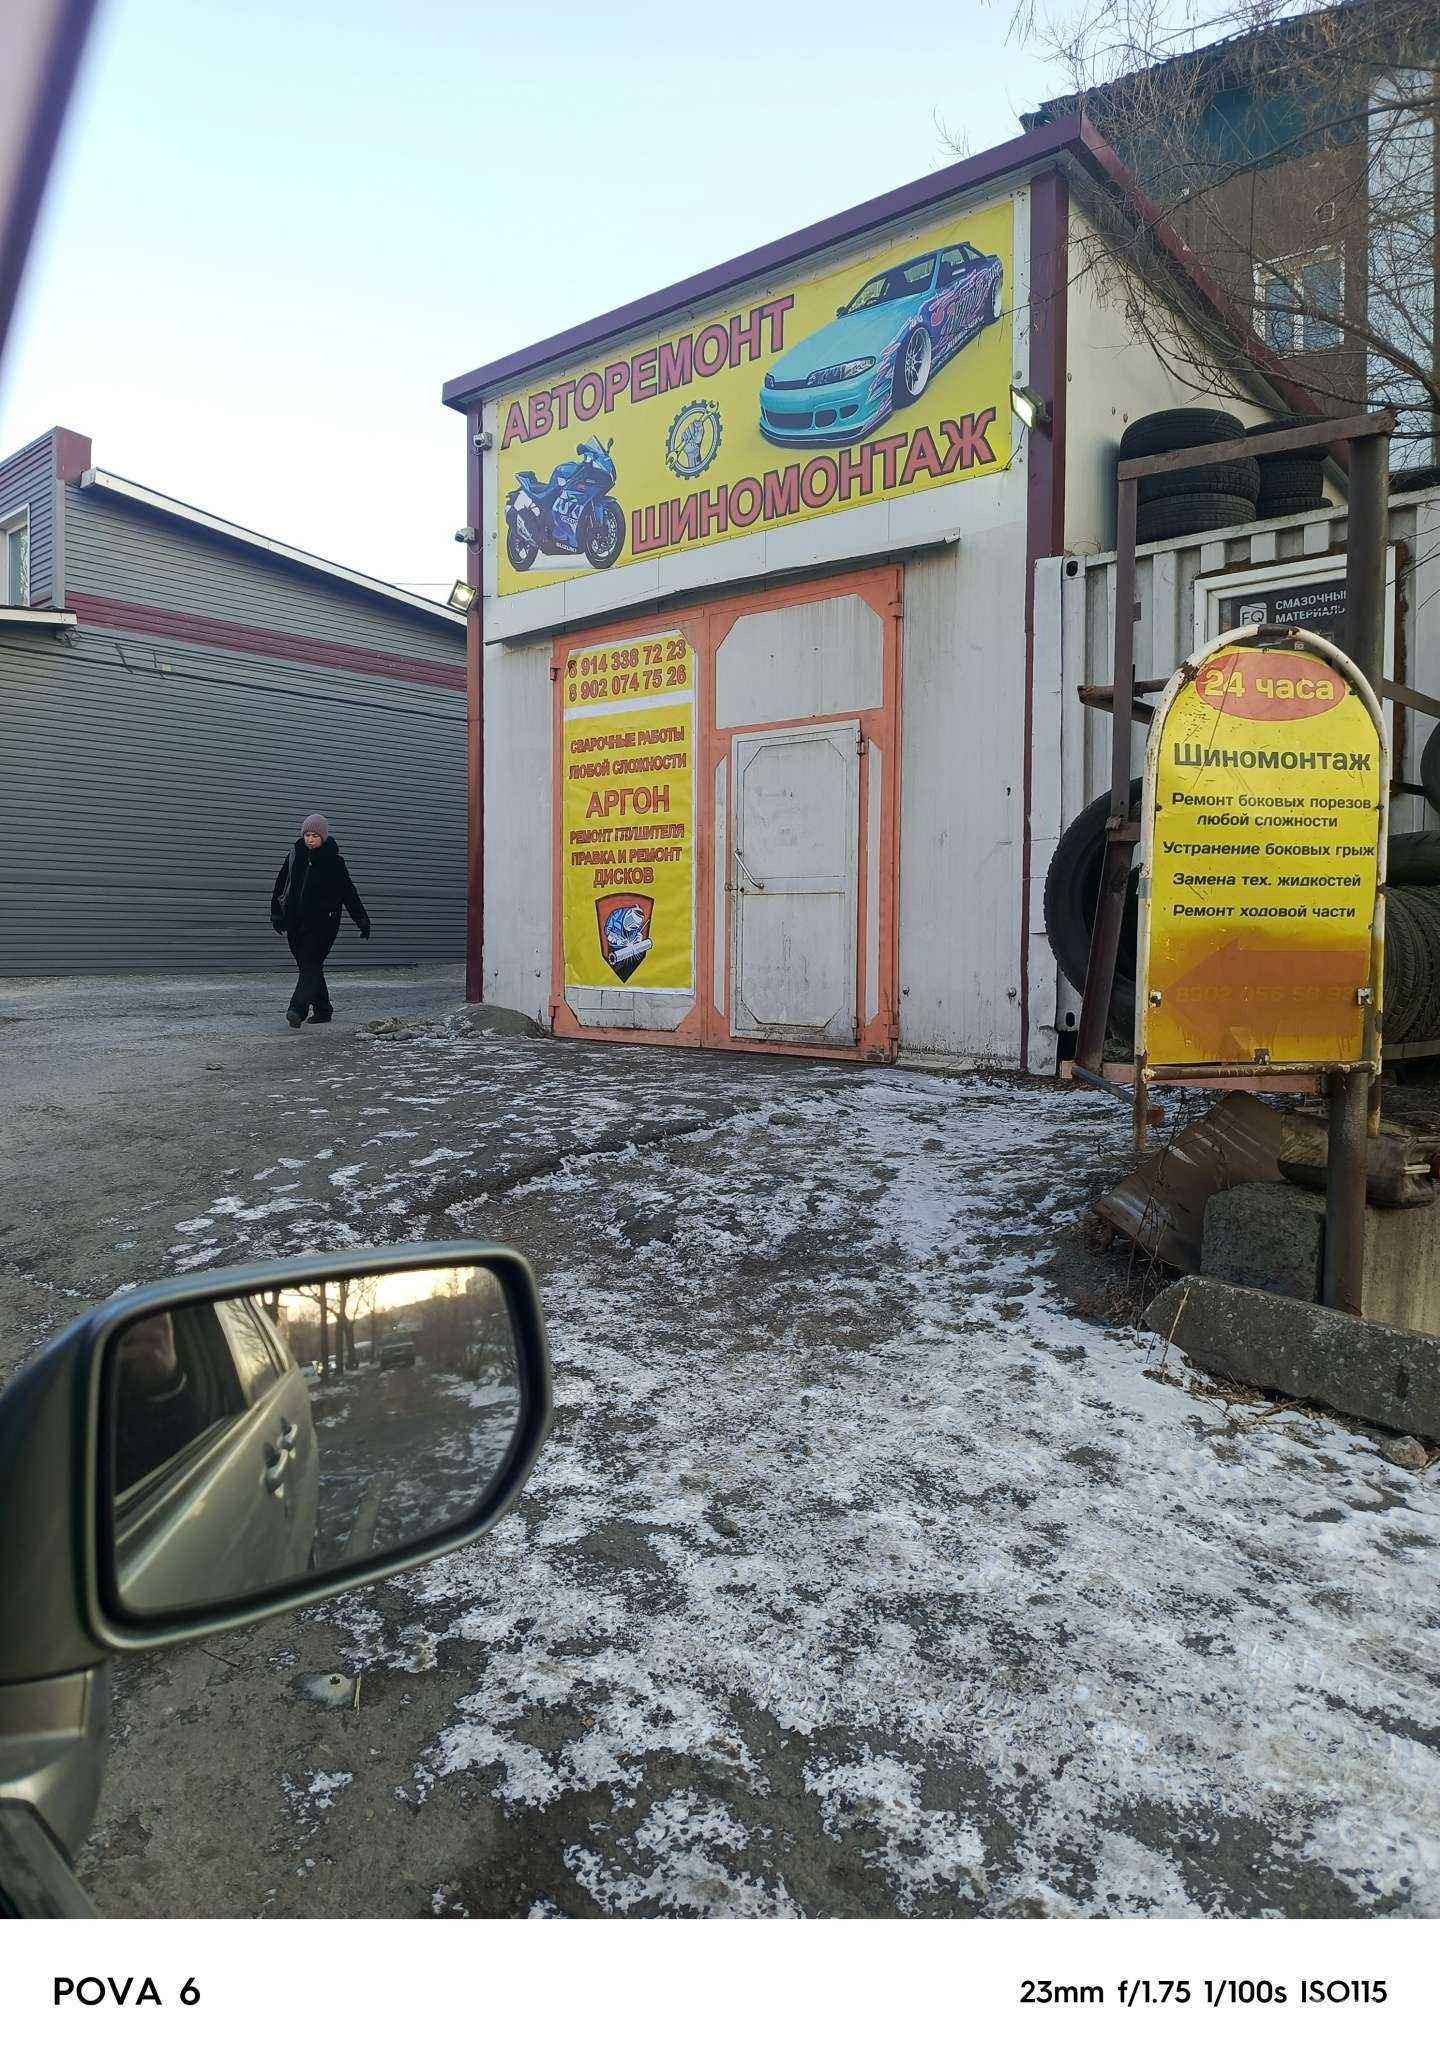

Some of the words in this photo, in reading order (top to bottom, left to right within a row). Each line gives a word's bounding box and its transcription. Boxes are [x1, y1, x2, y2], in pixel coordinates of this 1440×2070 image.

[500, 294, 795, 451] АВТОРЕМОНТ
[632, 406, 997, 555] ШИНОМОНТАЖ
[1275, 590, 1347, 610] СМАЗОЧНЫ
[567, 660, 577, 678] 8
[581, 654, 607, 676] 914
[611, 648, 639, 671] 338
[643, 643, 663, 665] 72
[666, 639, 686, 661] 23
[568, 683, 577, 702] 8
[581, 678, 607, 700] 902
[611, 672, 639, 695] 074
[643, 668, 663, 689] 75
[666, 664, 686, 686] 26
[1204, 669, 1245, 698] 24
[1255, 678, 1334, 700] часа
[570, 732, 636, 753] СВАРОЧНЫЕ
[638, 726, 685, 746] РАБОТЫ
[569, 758, 610, 780] ЛЮБОЙ
[613, 753, 687, 775] СЛОЖНОСТИ
[1174, 742, 1371, 771] Шиномонтаж
[585, 784, 670, 819] АРГОН
[1172, 792, 1234, 806] Ремонт
[1238, 792, 1304, 808] боковых
[1309, 796, 1372, 811] порезов
[1196, 812, 1249, 826] любой
[1254, 814, 1338, 828] сложности
[570, 827, 615, 844] РЕМОНТ
[615, 823, 684, 842] ГЛУШИТЕЛЯ
[571, 850, 615, 866] ПРАВКА
[617, 850, 627, 864] И
[629, 846, 682, 863] РЕМОНТ
[1163, 841, 1260, 856] Устранение
[1265, 842, 1331, 856] боковых
[1335, 845, 1375, 858] грыж
[593, 866, 654, 888] ДИСКОВ
[1173, 872, 1236, 886] Замена
[1242, 875, 1272, 886] тех.
[1277, 873, 1361, 887] жидкостей
[1173, 904, 1234, 917] Ремонт
[1240, 904, 1307, 918] ходовой
[1312, 906, 1355, 918] части
